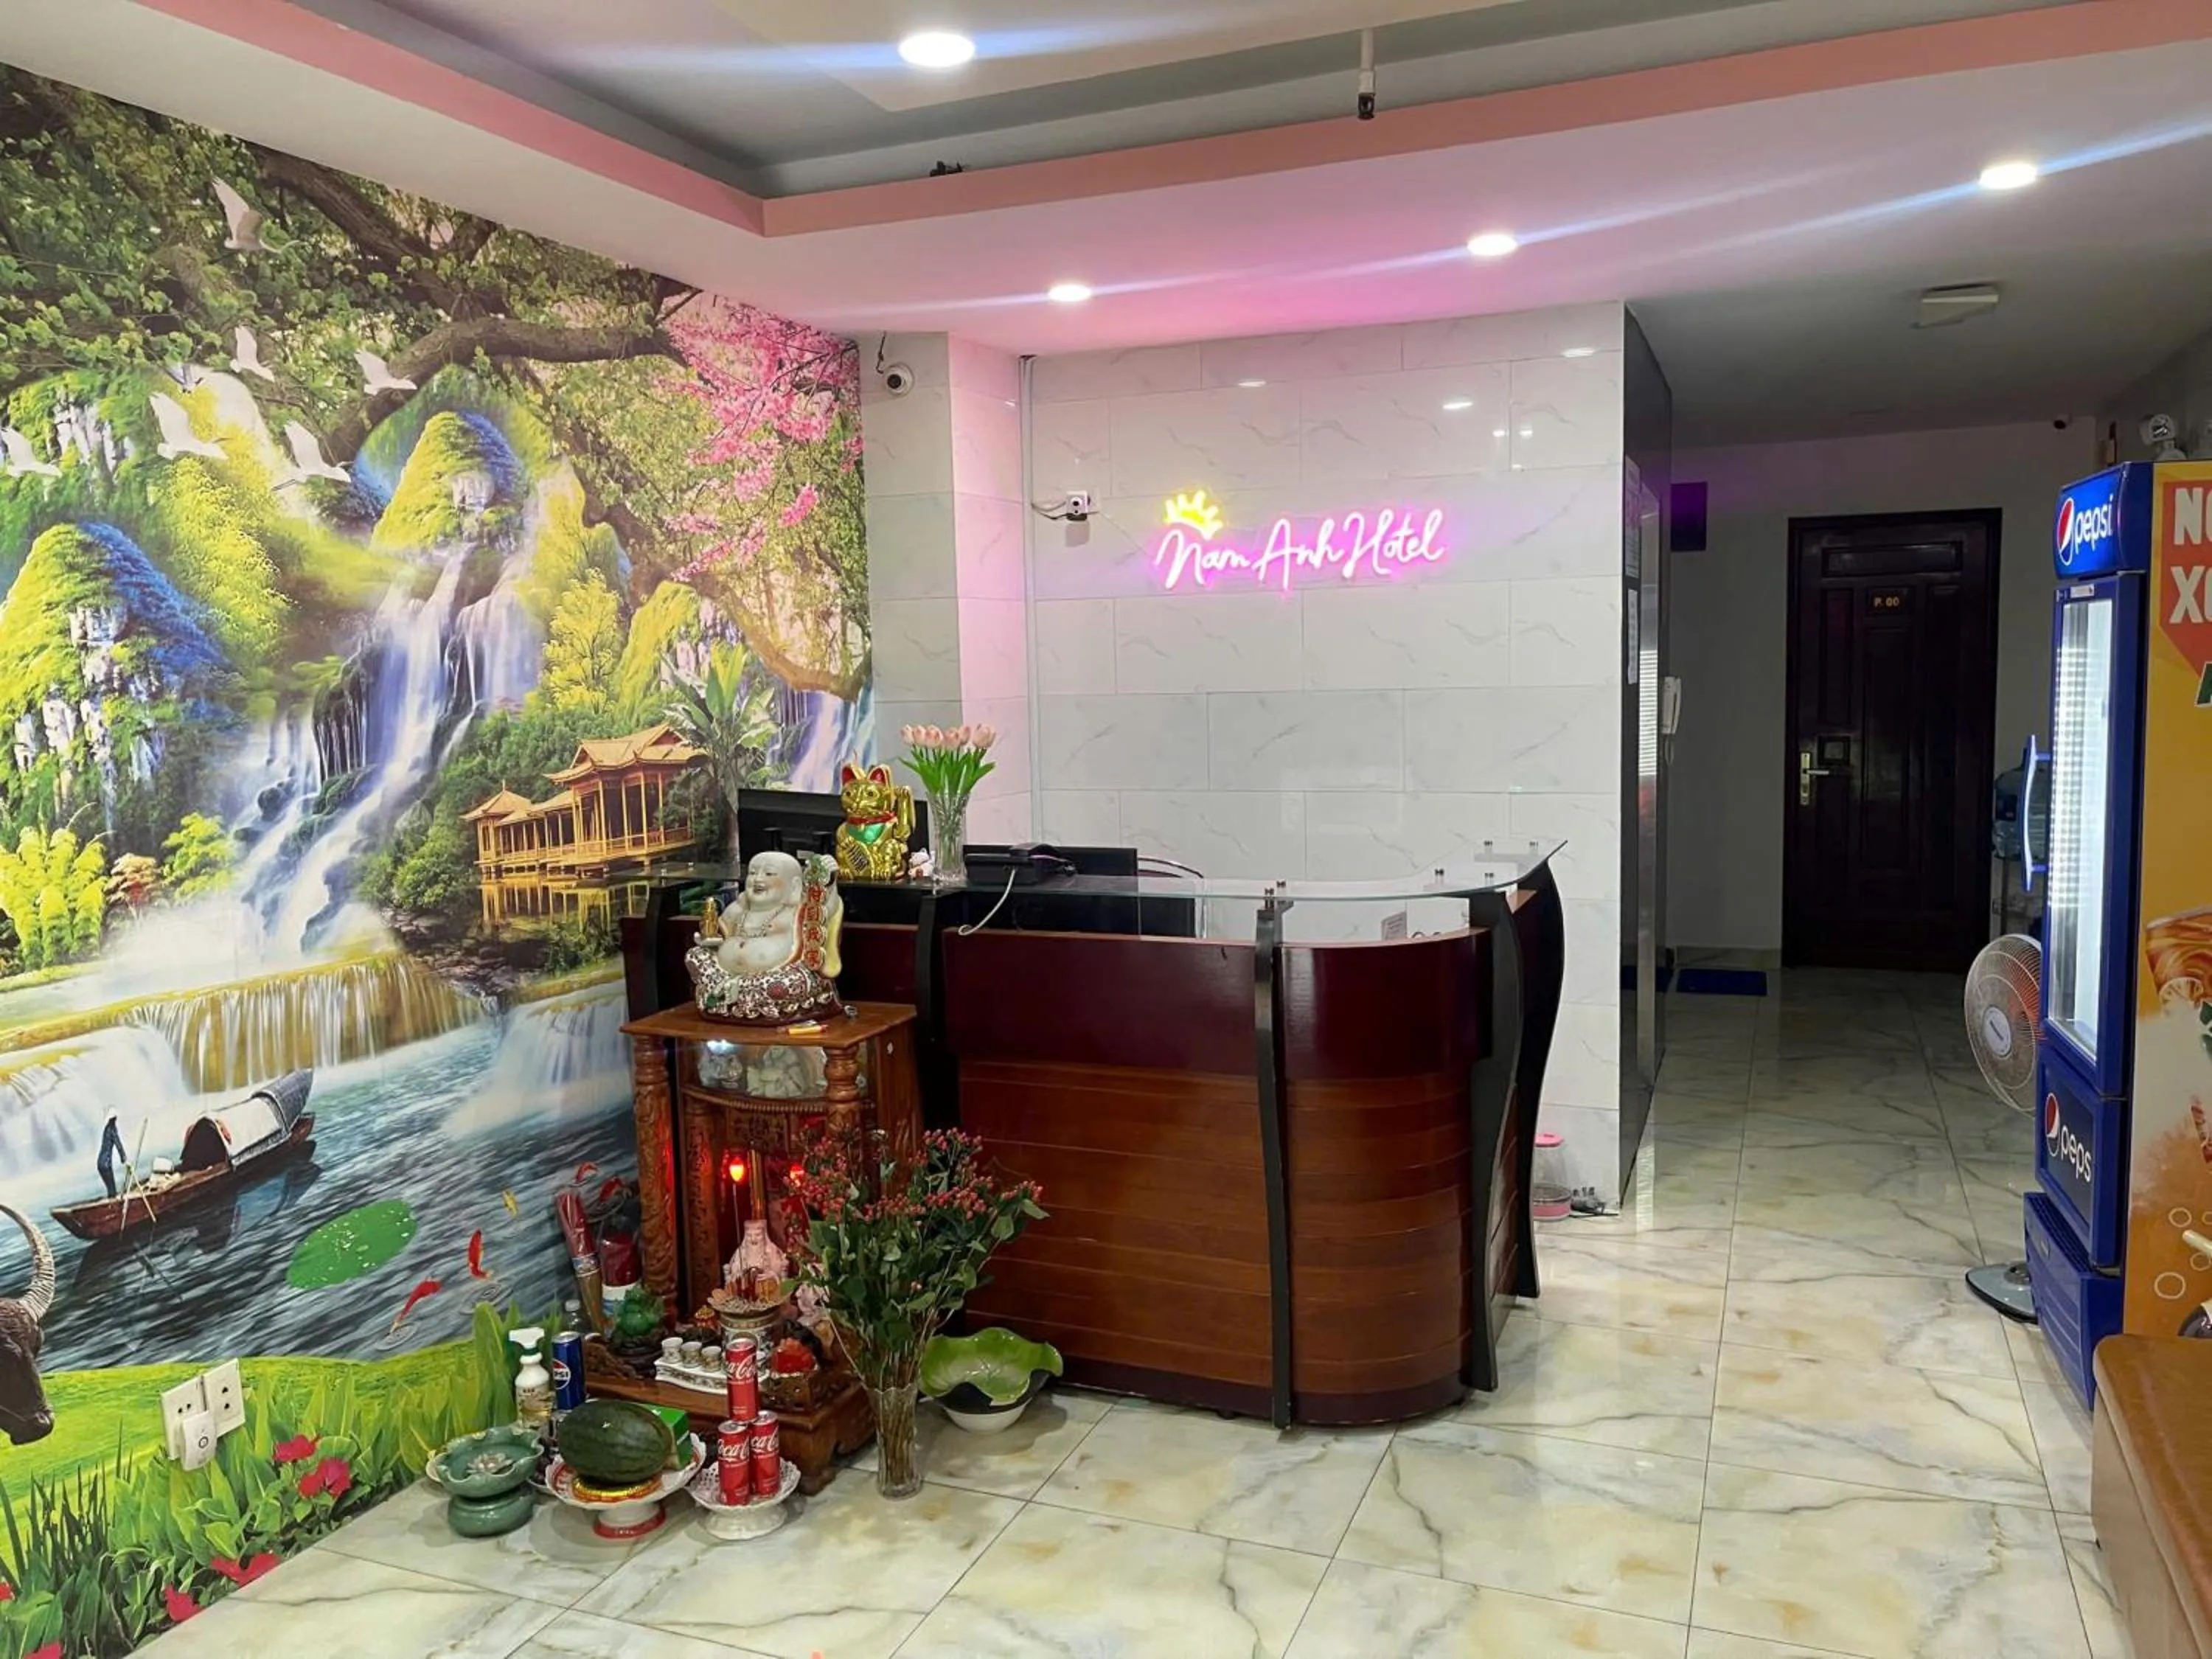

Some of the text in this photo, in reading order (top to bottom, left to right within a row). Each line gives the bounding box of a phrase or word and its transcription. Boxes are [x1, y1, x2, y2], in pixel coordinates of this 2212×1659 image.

[2074, 493, 2114, 554] pepsi
[2174, 487, 2212, 545] N
[1155, 509, 1445, 591] Nam Anh Hotel
[2169, 566, 2212, 624] X
[2061, 1123, 2093, 1183] peps
